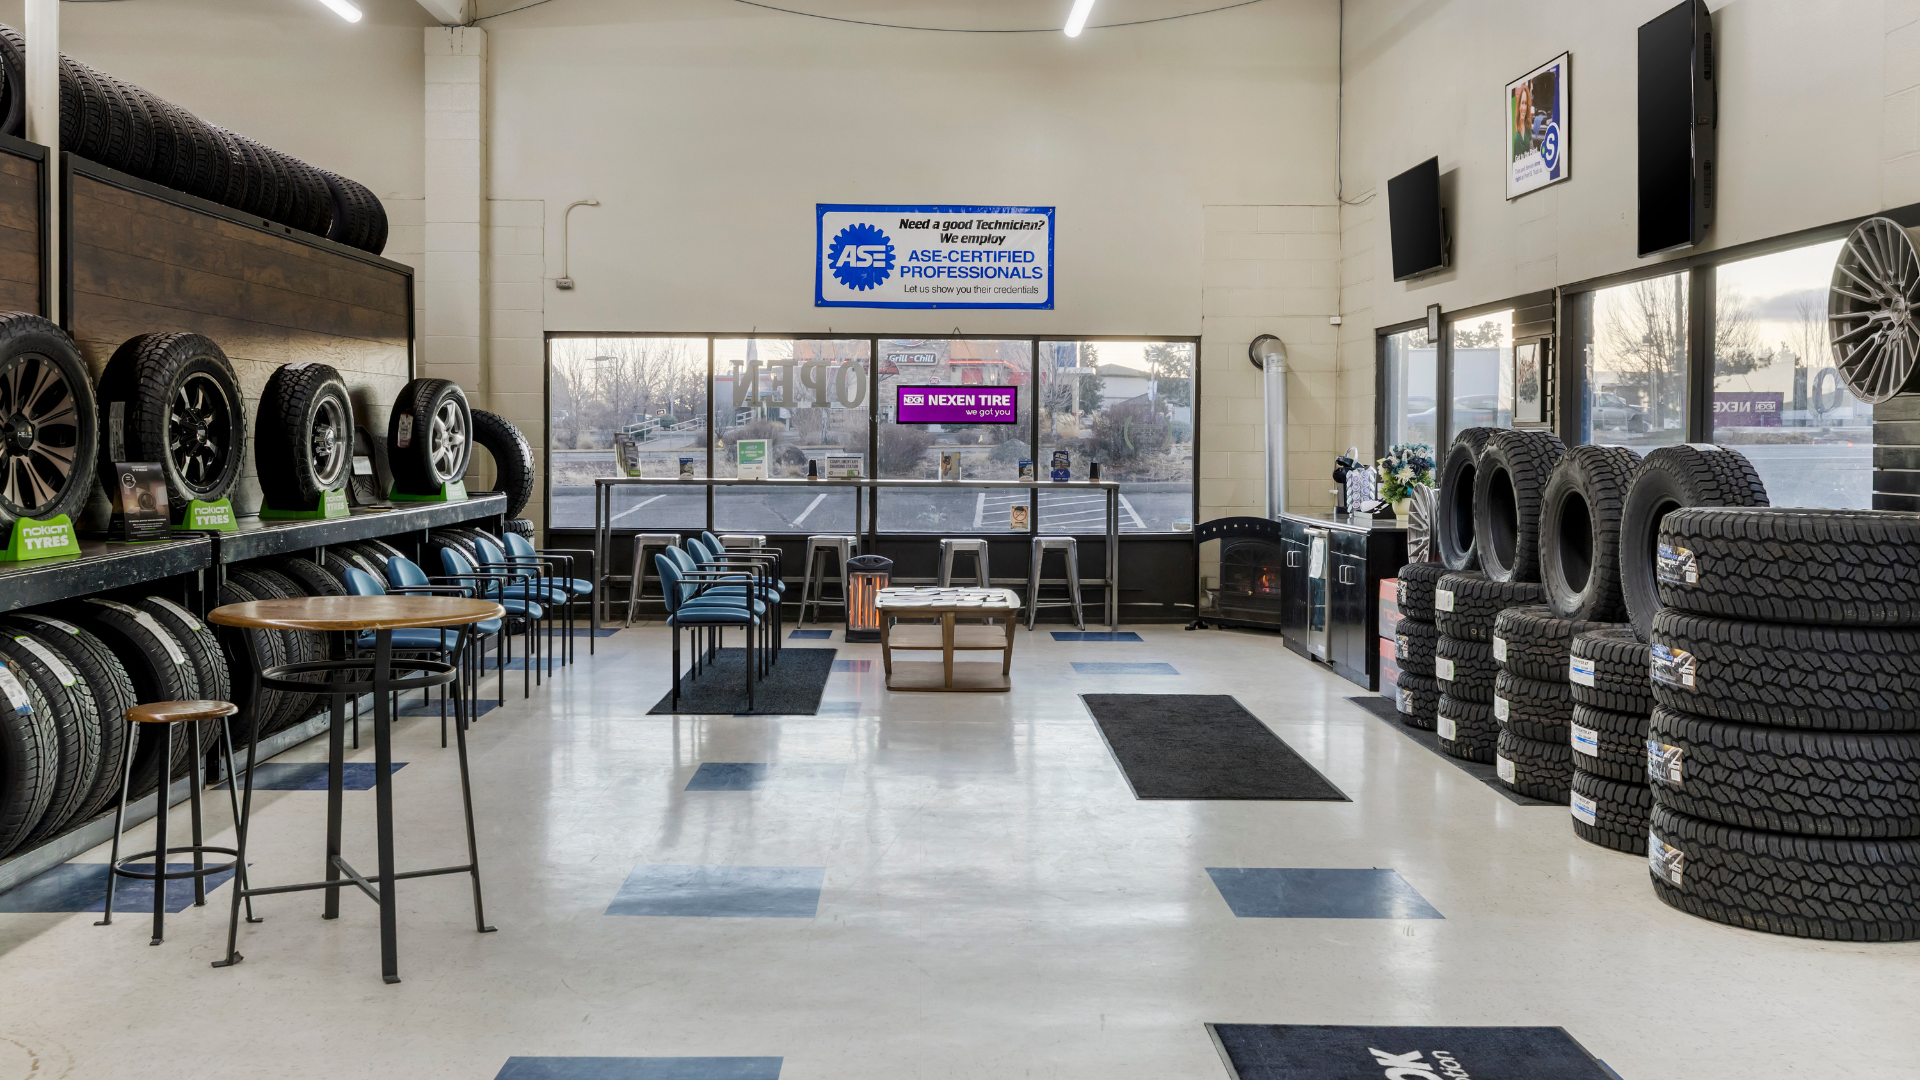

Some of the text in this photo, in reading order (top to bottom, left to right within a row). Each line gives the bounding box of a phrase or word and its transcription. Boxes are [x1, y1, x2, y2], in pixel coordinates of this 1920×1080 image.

[1546, 133, 1555, 160] S
[899, 219, 1045, 232] Need a good Technician?
[940, 233, 1006, 246] We employ
[836, 245, 886, 268] ASE
[908, 250, 1035, 263] ASE-CERTIFIED
[900, 266, 1043, 279] PROFESSIONALS
[904, 284, 1039, 296] Let us show you their credentials
[889, 354, 908, 362] Grill
[914, 353, 934, 363] Chill
[904, 394, 1011, 406] NEXEN NEXEN TIRE
[979, 408, 993, 418] got
[995, 409, 1011, 418] you
[327, 503, 345, 511] TYRES
[196, 515, 229, 525] TYRES
[24, 535, 69, 550] TYRES
